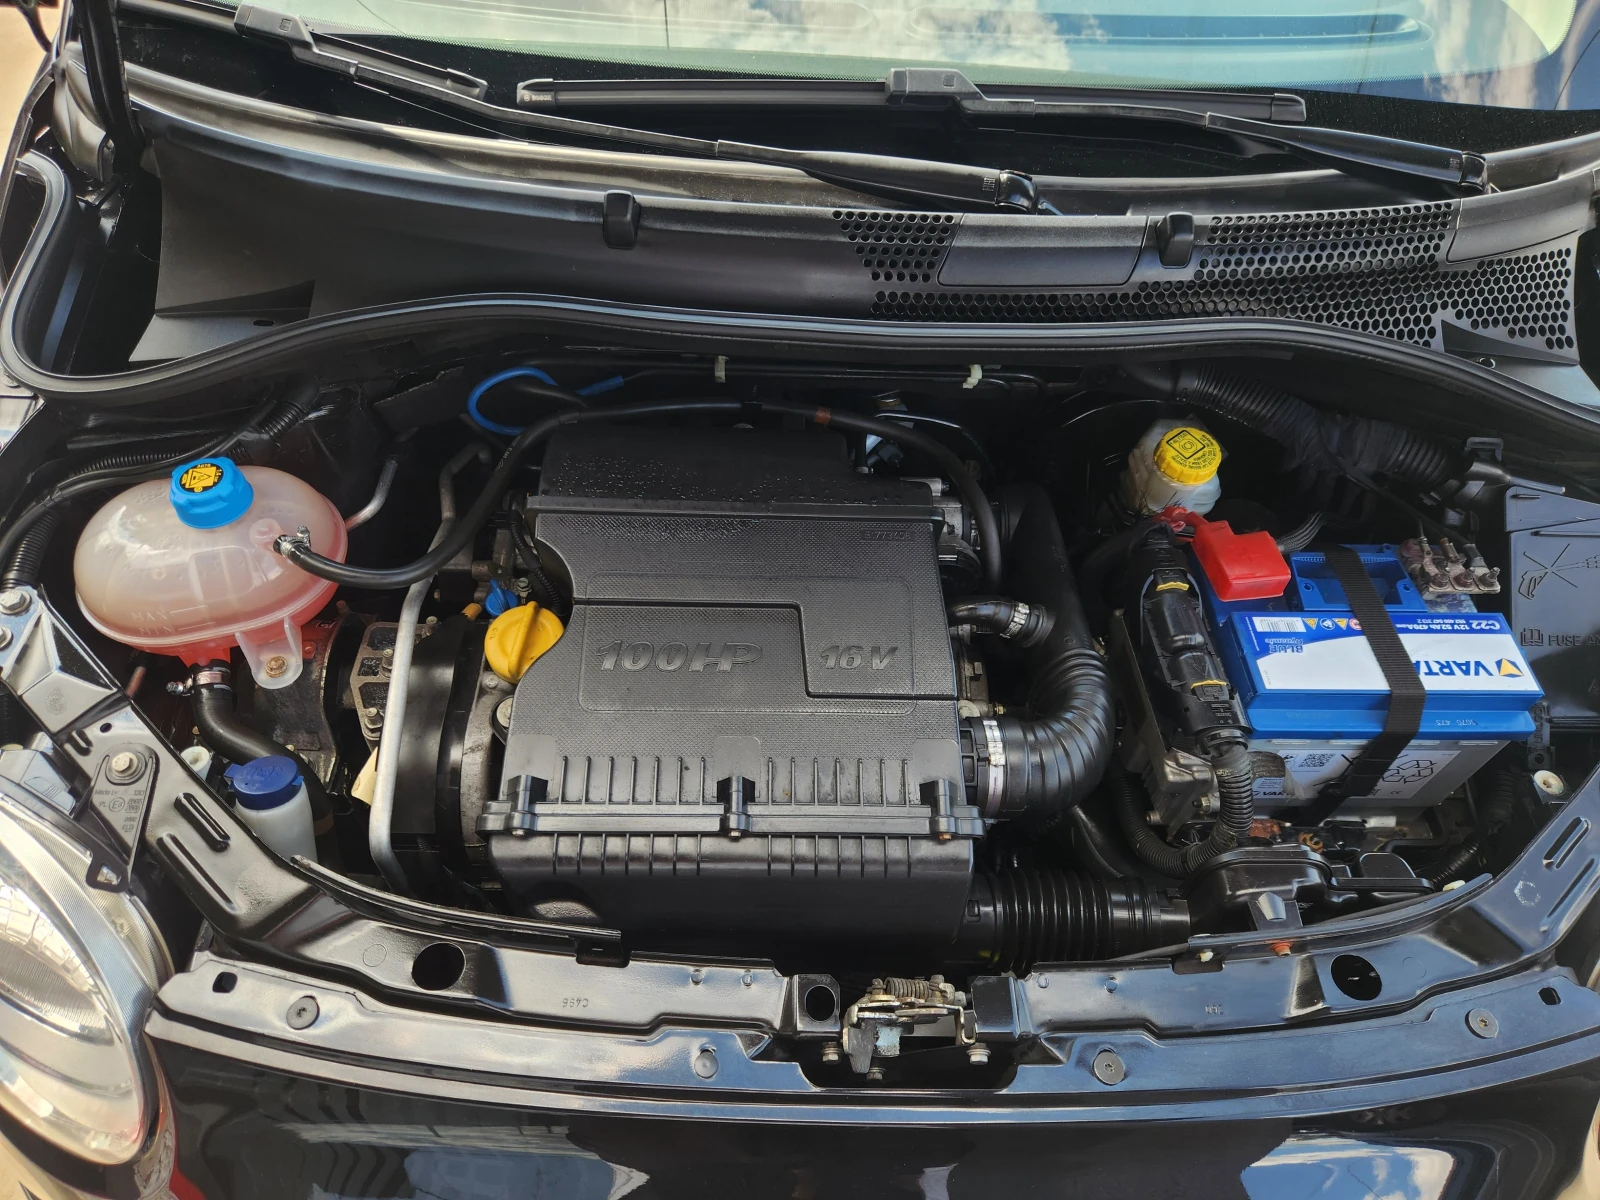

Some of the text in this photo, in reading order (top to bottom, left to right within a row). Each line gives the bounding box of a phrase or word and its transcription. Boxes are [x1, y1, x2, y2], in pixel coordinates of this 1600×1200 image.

[131, 609, 168, 621] MAX
[139, 624, 175, 636] MIN
[1469, 619, 1500, 630] C22
[1548, 634, 1582, 647] FUSE
[1269, 644, 1304, 654] BLUE
[596, 640, 899, 673] 100HP 16V
